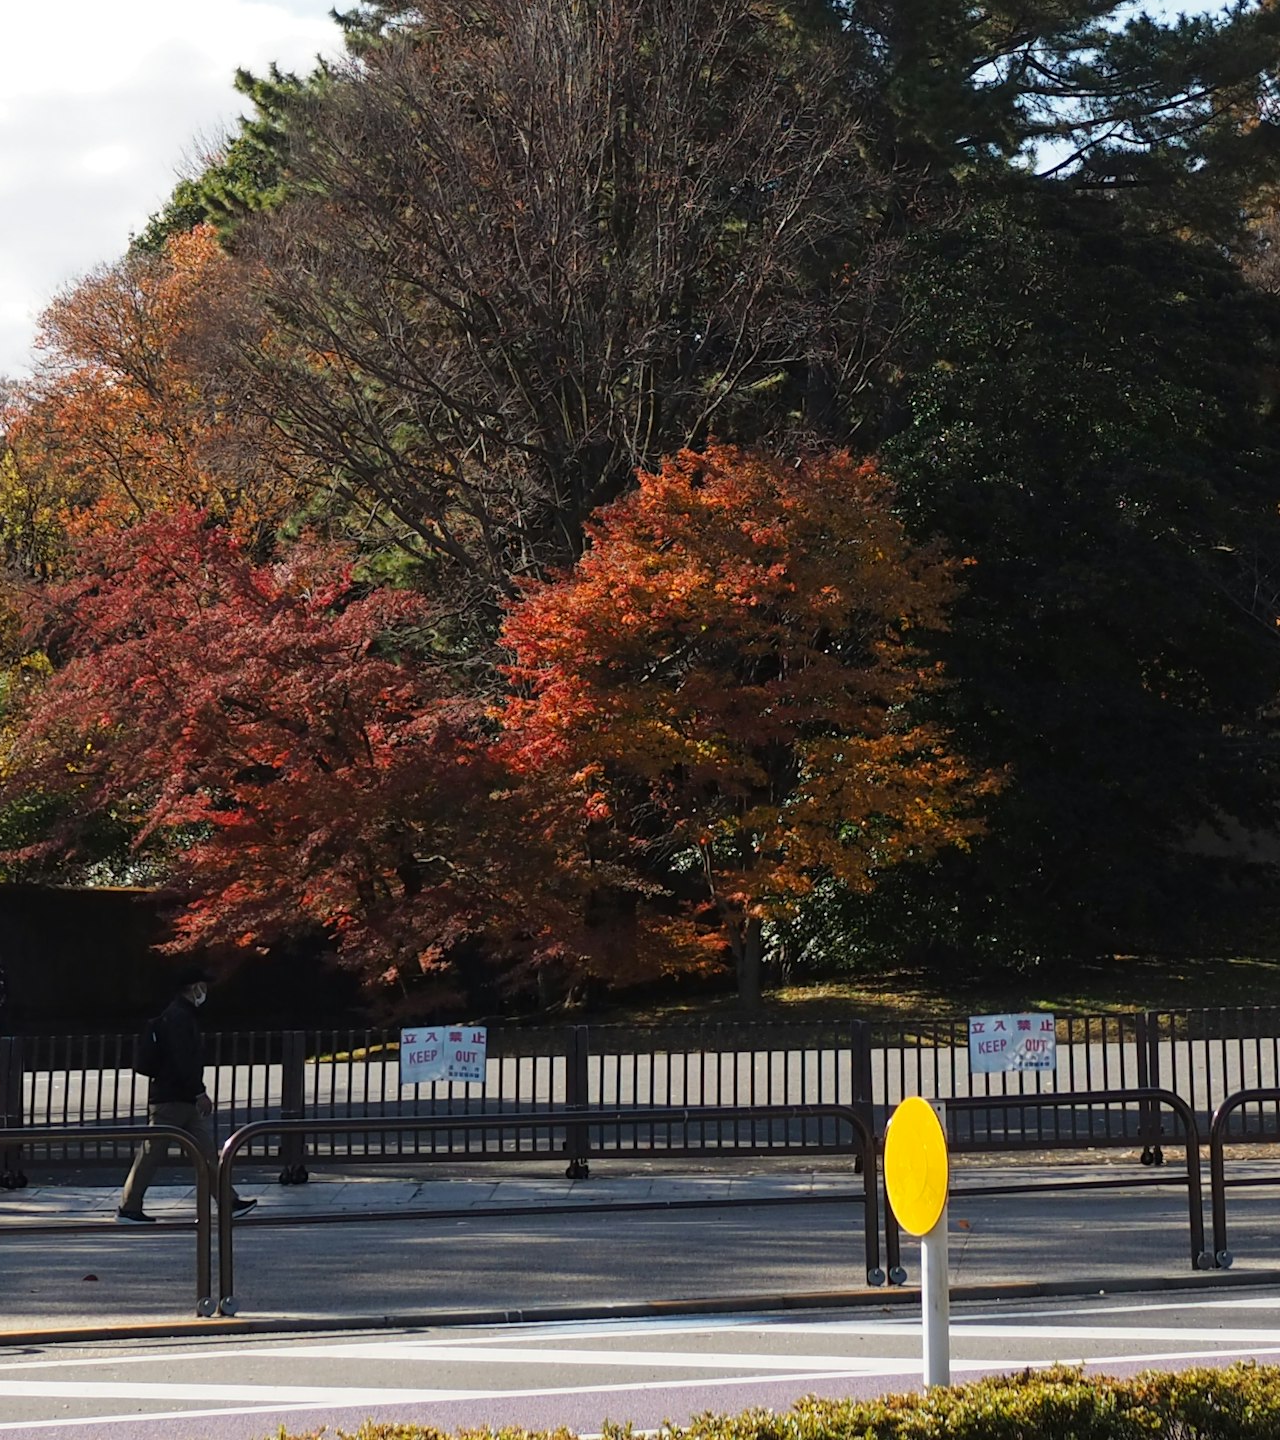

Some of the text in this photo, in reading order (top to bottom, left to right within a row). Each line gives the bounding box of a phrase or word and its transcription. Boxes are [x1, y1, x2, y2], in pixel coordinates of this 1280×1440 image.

[971, 1019, 1054, 1034] 立入禁止
[403, 1031, 485, 1045] 立入禁止
[978, 1039, 1048, 1054] KEEP OUT
[409, 1050, 477, 1065] KEEP OUT
